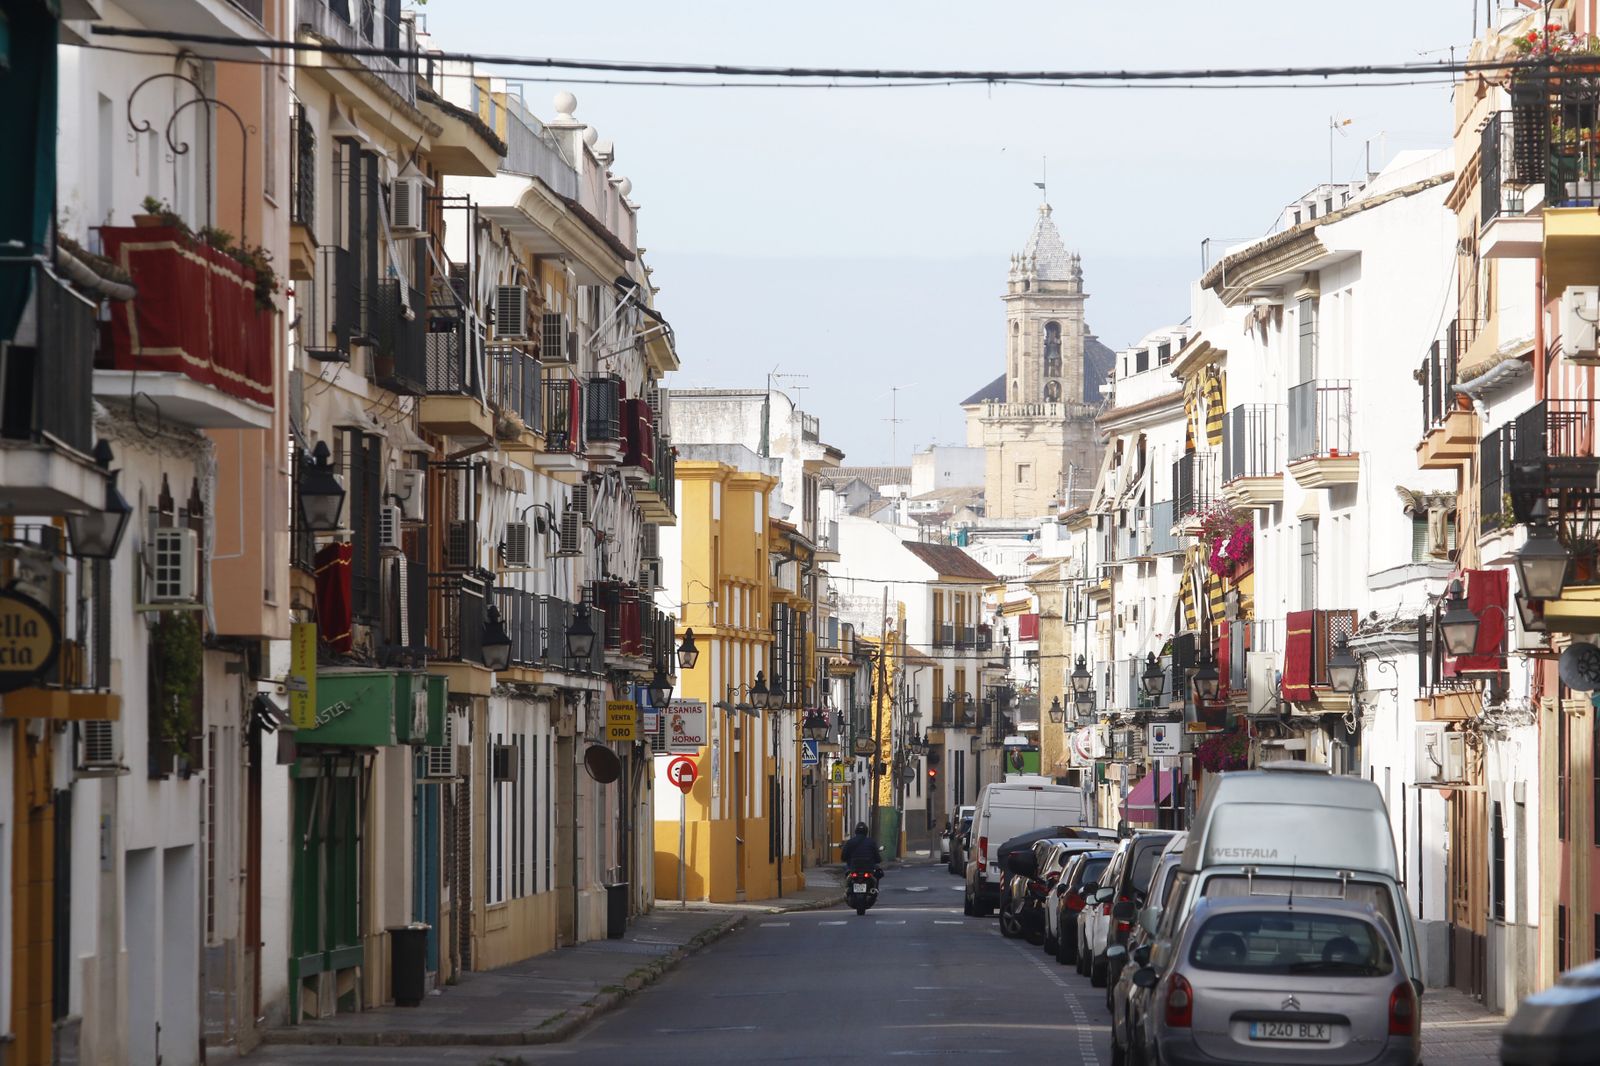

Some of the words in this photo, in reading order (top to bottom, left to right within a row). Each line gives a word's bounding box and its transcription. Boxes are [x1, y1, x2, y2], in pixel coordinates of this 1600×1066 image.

[313, 701, 351, 729] ASTEL
[660, 706, 702, 714] RTESANIAS
[611, 728, 631, 737] ORO
[1211, 848, 1278, 858] WESTFALIA
[1262, 1023, 1294, 1037] 1240
[1299, 1024, 1324, 1038] BLX
